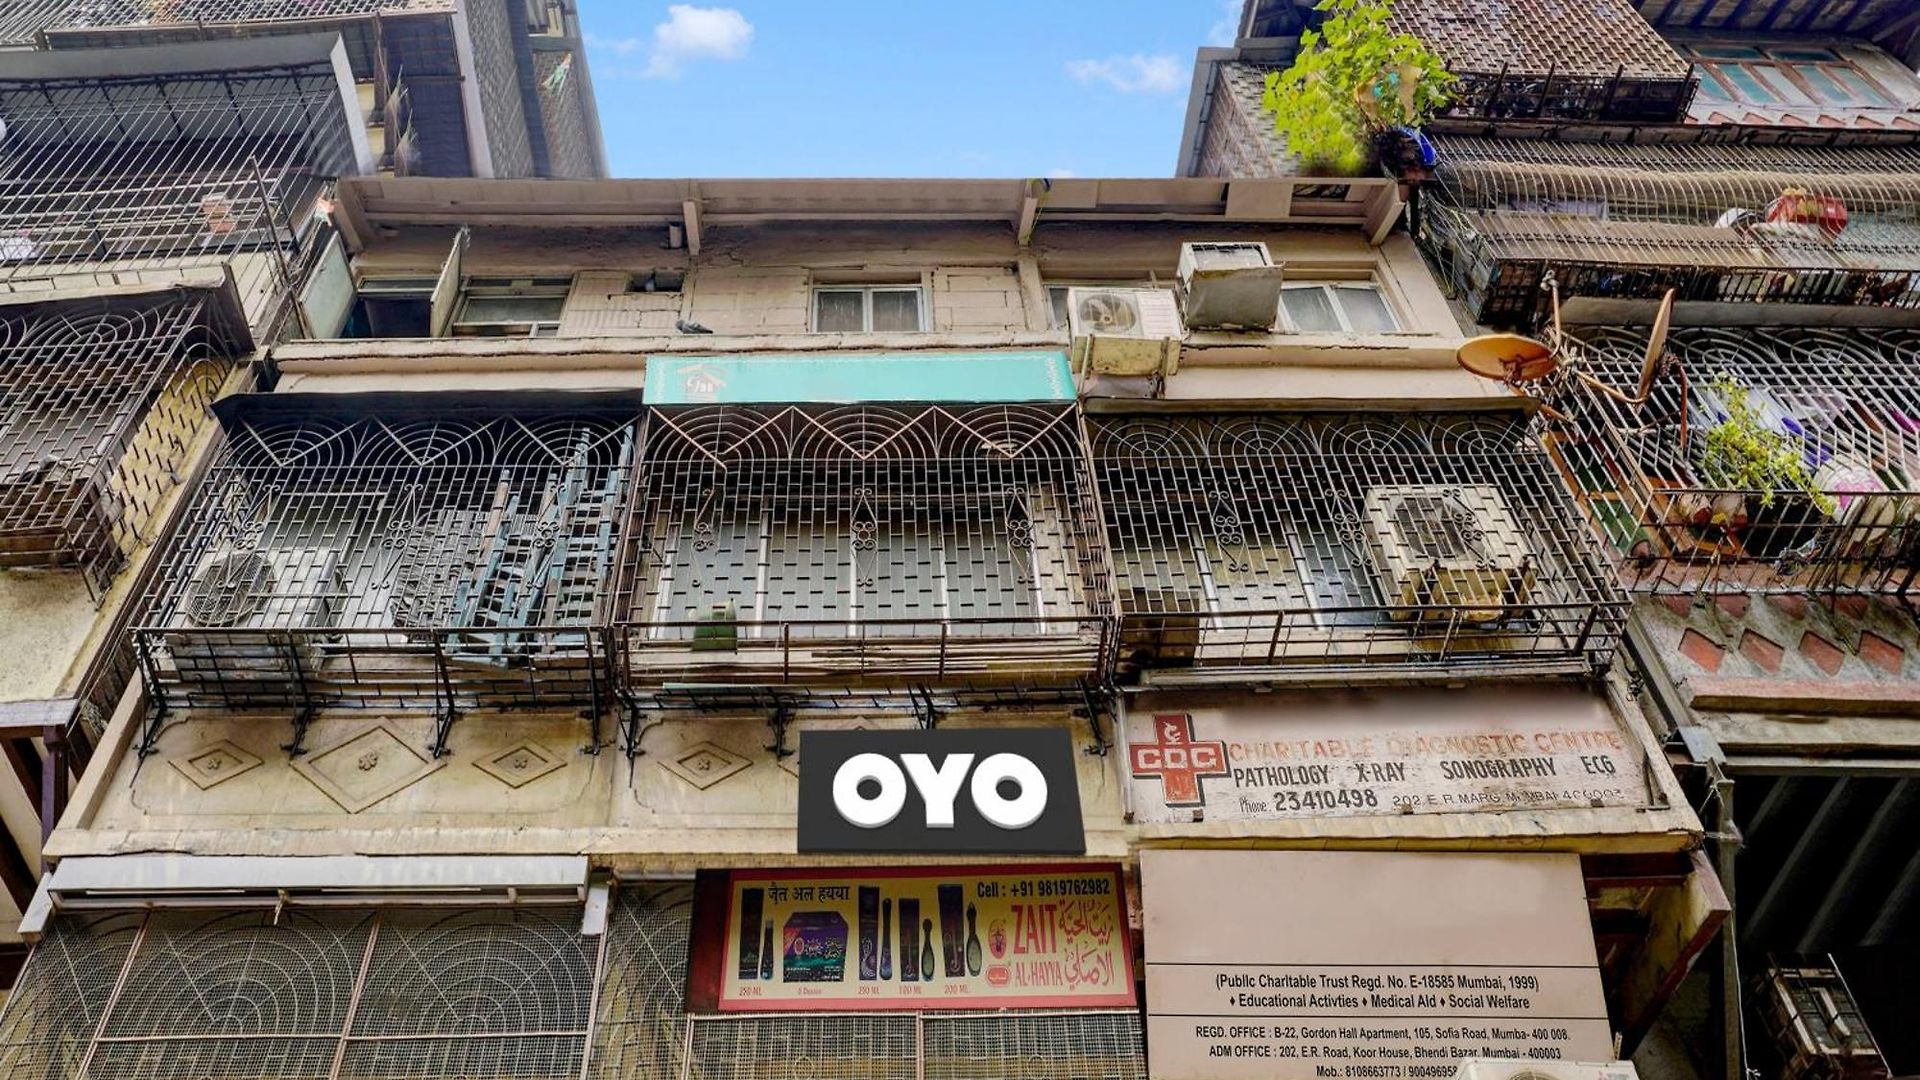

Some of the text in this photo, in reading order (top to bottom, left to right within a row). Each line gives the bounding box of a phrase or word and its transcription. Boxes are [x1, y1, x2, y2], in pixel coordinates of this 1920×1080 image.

[1137, 748, 1217, 769] CDC
[1235, 755, 1616, 788] PATHOLOGY X-RAY SONOGRAPHY ECG
[833, 753, 1048, 829] OYO
[1274, 789, 1378, 811] 23410498
[977, 882, 999, 897] Cell
[1011, 881, 1033, 897] +91
[1038, 879, 1110, 896] 9819762982
[1011, 904, 1057, 954] ZAIT
[1016, 961, 1063, 986] AL-HAYYA
[1216, 973, 1540, 992] (Public Charitable Trust Regd. No. E-18585 Mumbai, 1999)
[1239, 993, 1530, 1010] Educational Activties Medical Aid Social Welfare
[1196, 1025, 1228, 1039] REGD.
[1229, 1025, 1266, 1039] OFFICE
[1274, 1026, 1299, 1040] B-22,
[1301, 1026, 1337, 1040] Gordon
[1339, 1026, 1358, 1040] Hall
[1360, 1027, 1412, 1043] Apartment,
[1414, 1027, 1433, 1041] 105,
[1435, 1027, 1460, 1040] Sofia
[1462, 1027, 1490, 1042] Road,
[1532, 1027, 1548, 1041] 400
[1209, 1045, 1232, 1057] ADM
[1234, 1045, 1271, 1058] OFFICE
[1279, 1046, 1299, 1058] 202,
[1301, 1046, 1319, 1058] E.R.
[1323, 1046, 1351, 1060] Road,
[1353, 1046, 1376, 1058] Koor
[1379, 1046, 1412, 1060] House,
[1414, 1046, 1449, 1059] Bhendi
[1481, 1047, 1520, 1060] Mumbai
[1527, 1047, 1561, 1060] 400003
[1316, 1065, 1343, 1077] Mob.:
[1344, 1065, 1401, 1078] 8108663773
